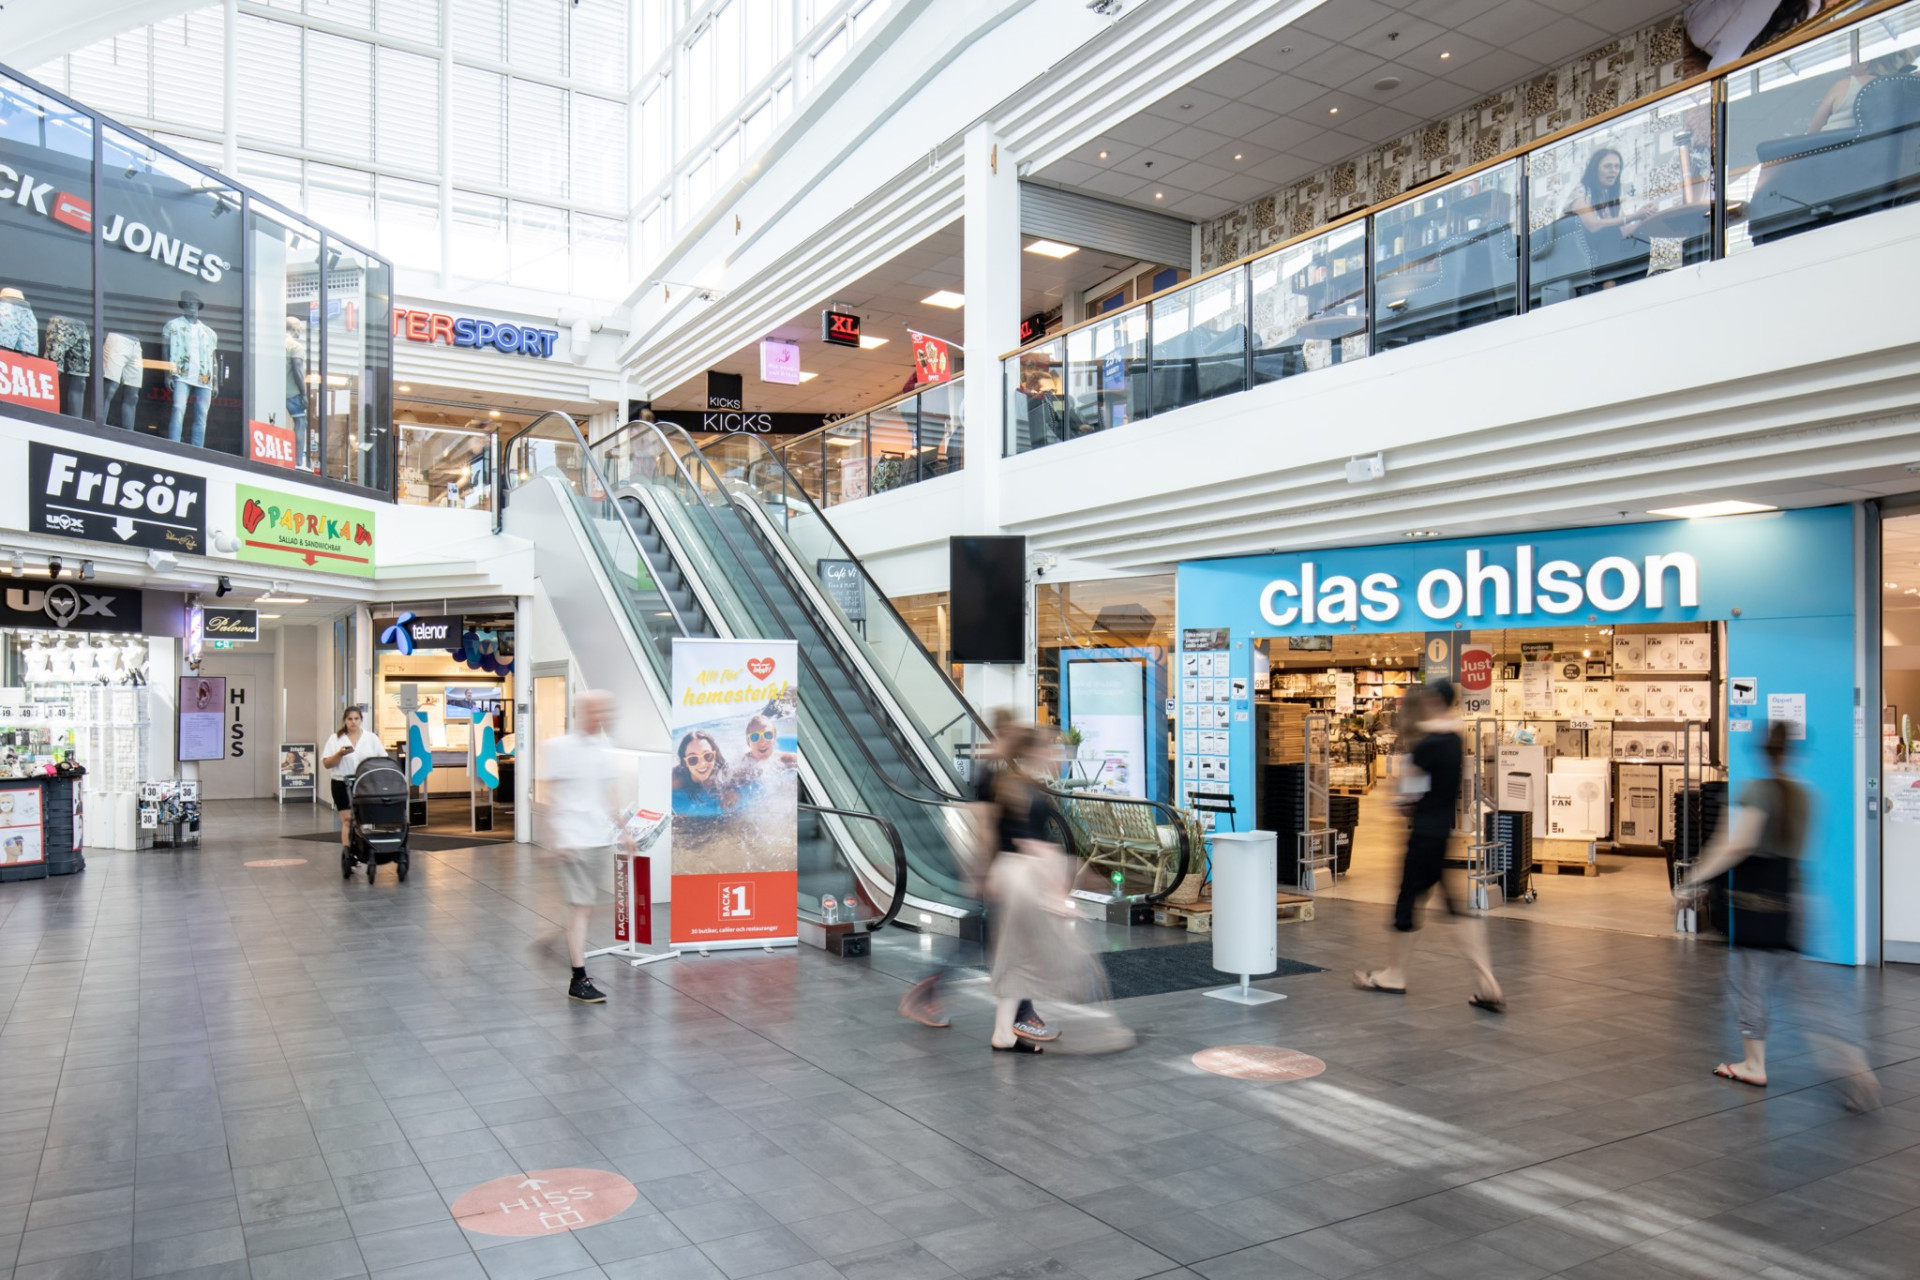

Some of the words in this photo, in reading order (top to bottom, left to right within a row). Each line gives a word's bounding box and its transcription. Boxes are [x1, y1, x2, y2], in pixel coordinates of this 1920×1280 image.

[103, 213, 223, 283] JONES
[831, 315, 859, 335] XL
[0, 361, 55, 400] SALE
[709, 396, 741, 410] KICKS
[703, 413, 772, 433] KICKS
[253, 430, 293, 462] SALE
[46, 453, 198, 518] Frisör
[268, 505, 351, 541] PAPRIKA
[278, 535, 299, 546] SALLAD
[305, 539, 341, 552] SANDWICHBAR
[827, 565, 847, 581] Café
[848, 567, 858, 578] Vi
[1258, 561, 1400, 627] clas
[1416, 544, 1699, 620] ohlson
[206, 615, 256, 634] Paloma
[412, 622, 449, 641] telenor
[1461, 658, 1492, 673] Just
[696, 668, 718, 687] Allt
[1467, 672, 1486, 683] nu
[230, 688, 245, 758] HISS
[148, 787, 157, 797] 30
[1552, 799, 1572, 807] FAN
[143, 814, 152, 824] 30
[617, 871, 626, 936] BACKAPLAN
[722, 886, 731, 917] BACKA
[731, 886, 751, 917] 1
[698, 927, 719, 936] butiker,
[746, 925, 779, 934] restauranger
[499, 1186, 594, 1214] HISS
